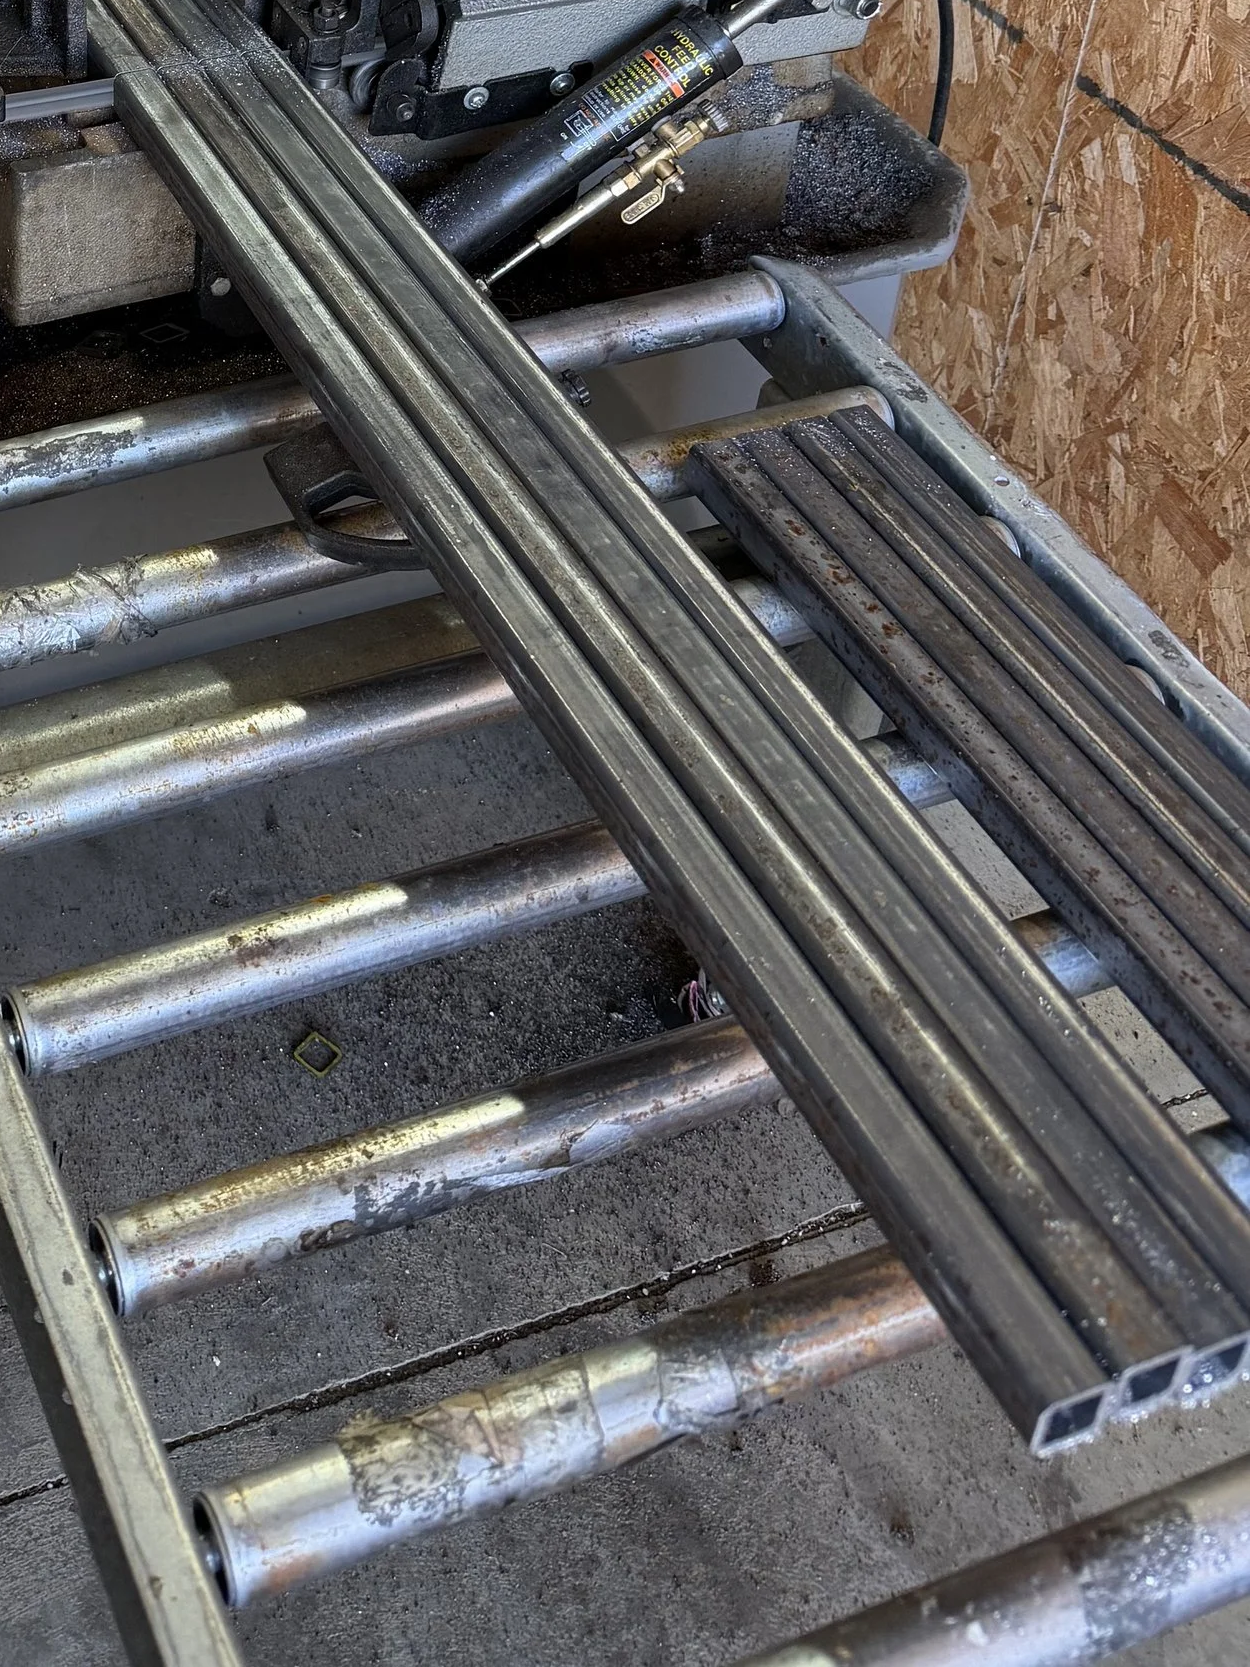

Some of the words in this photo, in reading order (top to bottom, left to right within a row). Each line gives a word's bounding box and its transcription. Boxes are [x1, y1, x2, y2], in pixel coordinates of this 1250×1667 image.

[653, 44, 692, 87] CONTROL
[670, 29, 714, 76] HYDRAULIC
[671, 44, 696, 71] FEED
